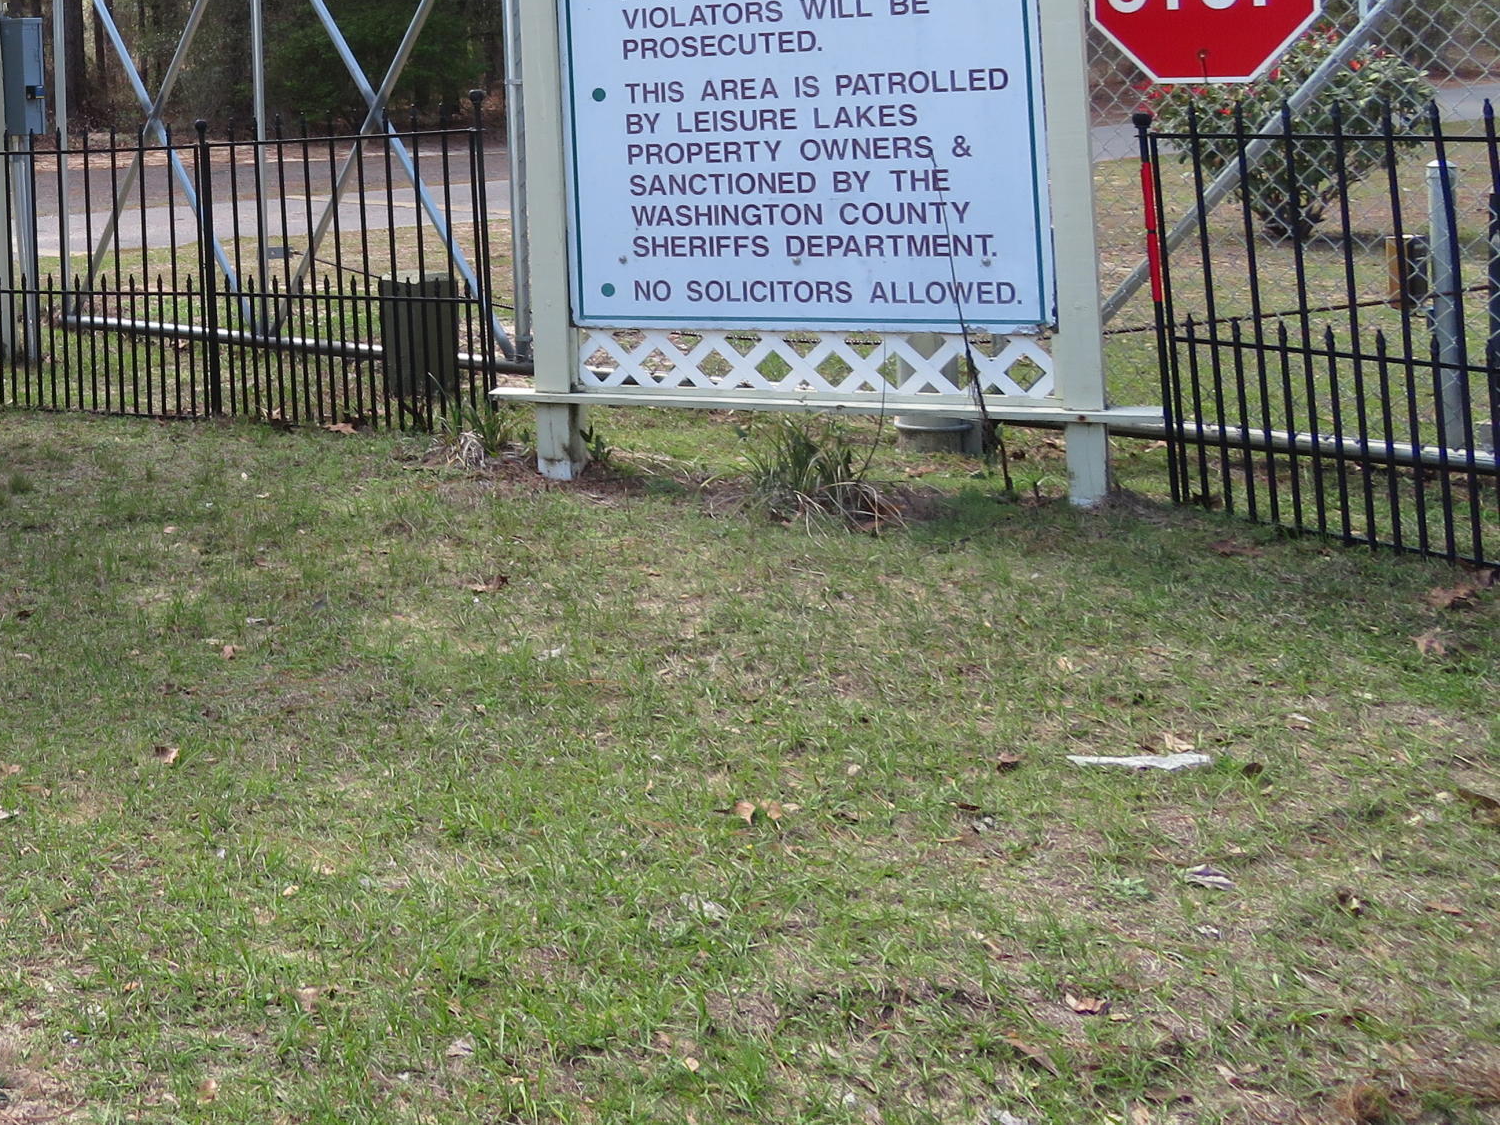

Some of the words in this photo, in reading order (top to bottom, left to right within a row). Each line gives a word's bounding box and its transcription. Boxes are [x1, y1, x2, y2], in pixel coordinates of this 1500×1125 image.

[622, 0, 783, 30] VIOLATORS
[622, 30, 822, 60] PROSECUTED.
[625, 81, 684, 104] THIS
[700, 77, 779, 102] AREA
[794, 76, 819, 98] IS
[836, 68, 1008, 96] PATROLLED
[626, 113, 660, 135] BY
[677, 108, 797, 134] LEISURE
[813, 104, 918, 129] LAKES
[627, 140, 782, 166] PROPERTY
[799, 136, 933, 161] OWNERS
[951, 136, 972, 158] &
[629, 171, 816, 196] SANCTIONED
[833, 171, 870, 193] BY
[889, 169, 951, 192] THE
[632, 204, 823, 227] WASHINGTON
[839, 201, 970, 225] COUNTY
[632, 235, 770, 258] SHERIFFS
[786, 234, 997, 258] DEPARTMENT.
[634, 280, 672, 302] NO
[686, 280, 853, 304] SOLICITORS
[869, 281, 1022, 305] ALLOWED.
